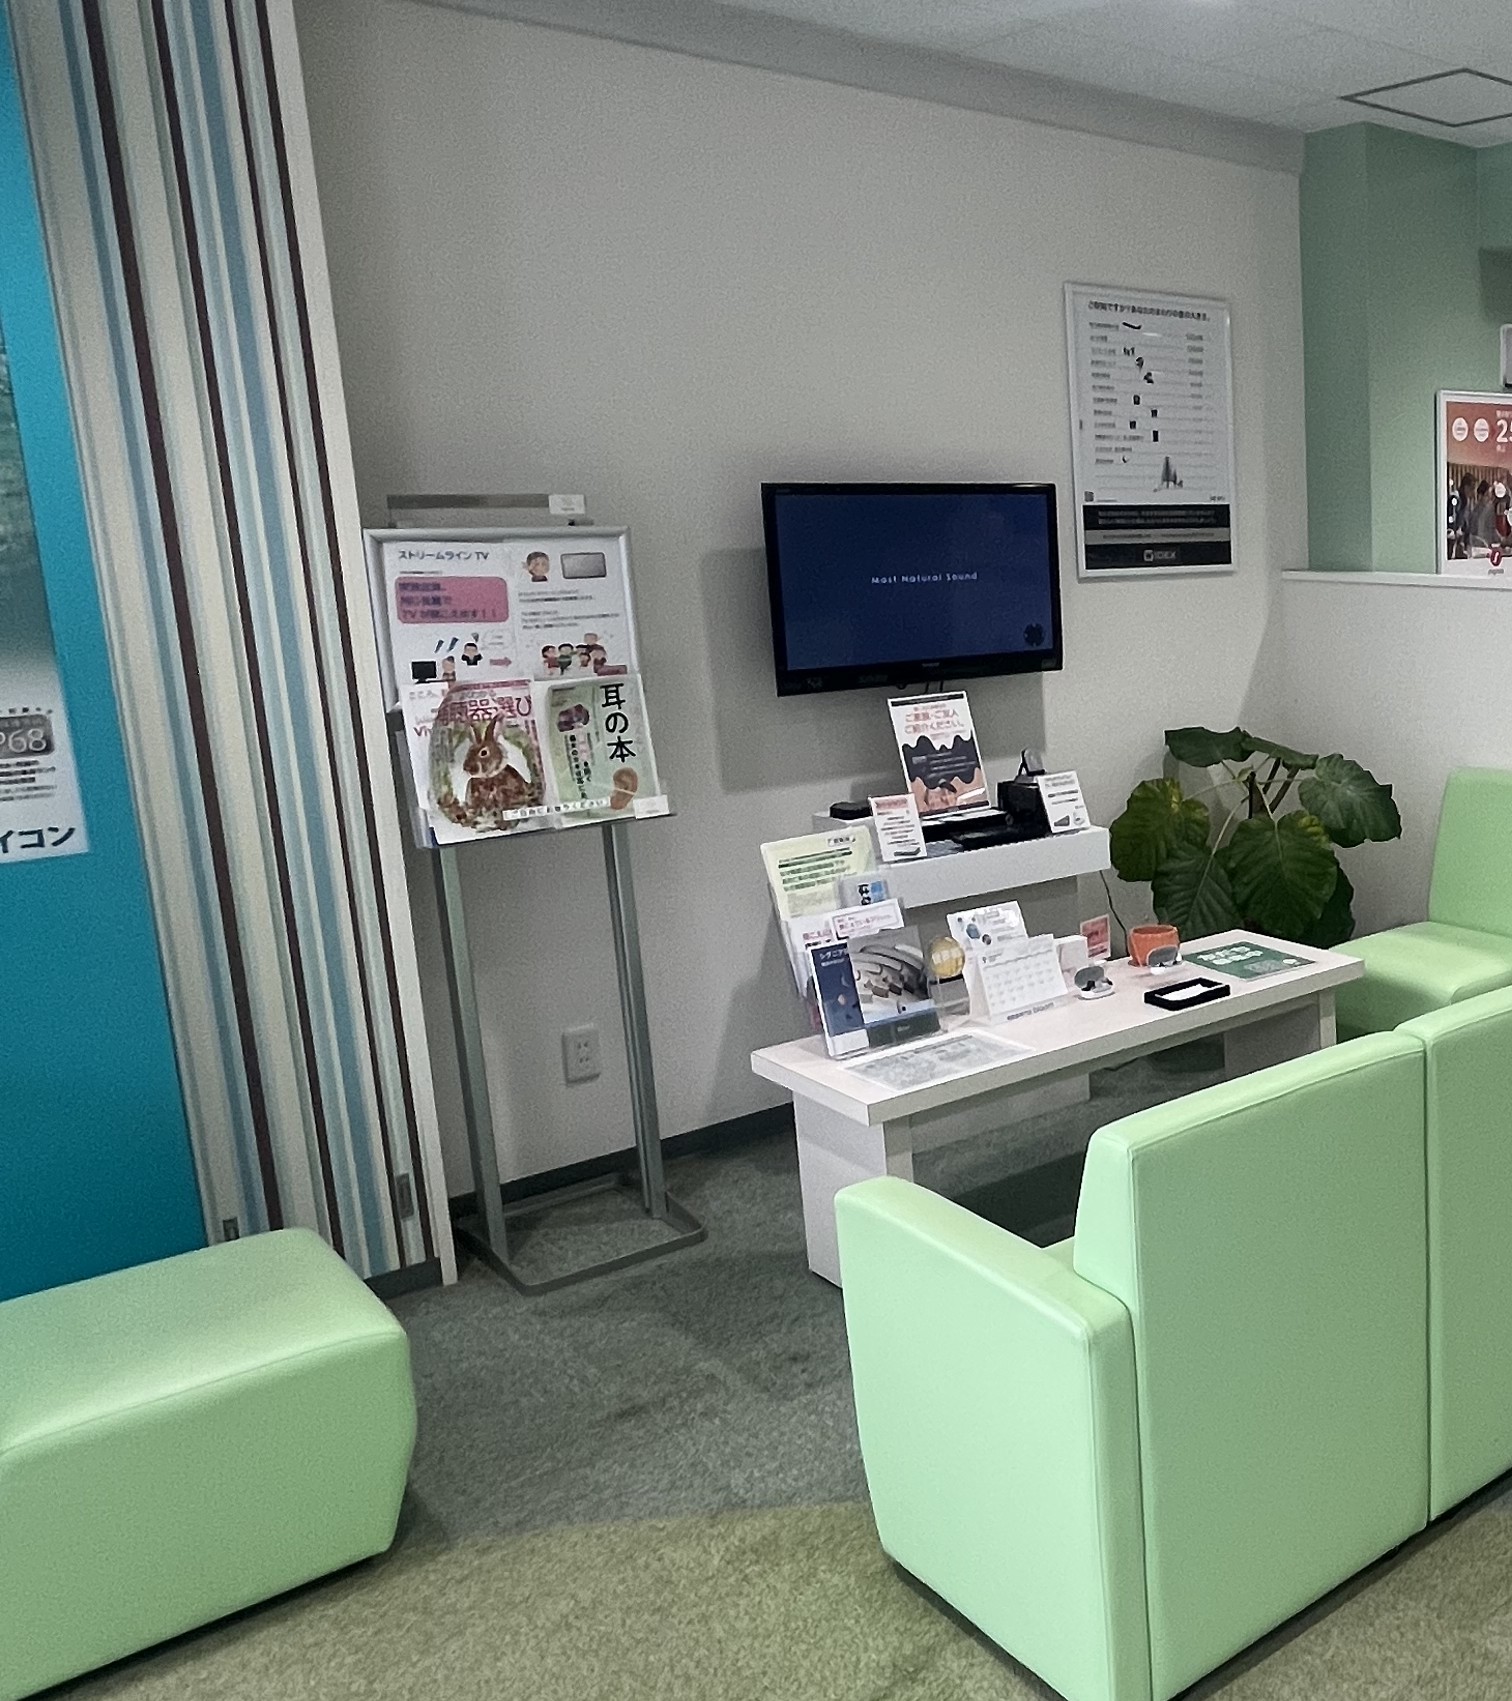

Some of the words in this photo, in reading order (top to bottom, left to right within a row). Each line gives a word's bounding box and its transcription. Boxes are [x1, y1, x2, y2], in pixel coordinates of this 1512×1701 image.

[399, 550, 471, 561] ストリームライン
[475, 551, 490, 561] TV
[872, 575, 897, 584] Most
[902, 573, 942, 583] Natural
[946, 571, 977, 581] Sound
[600, 682, 637, 763] 耳の本
